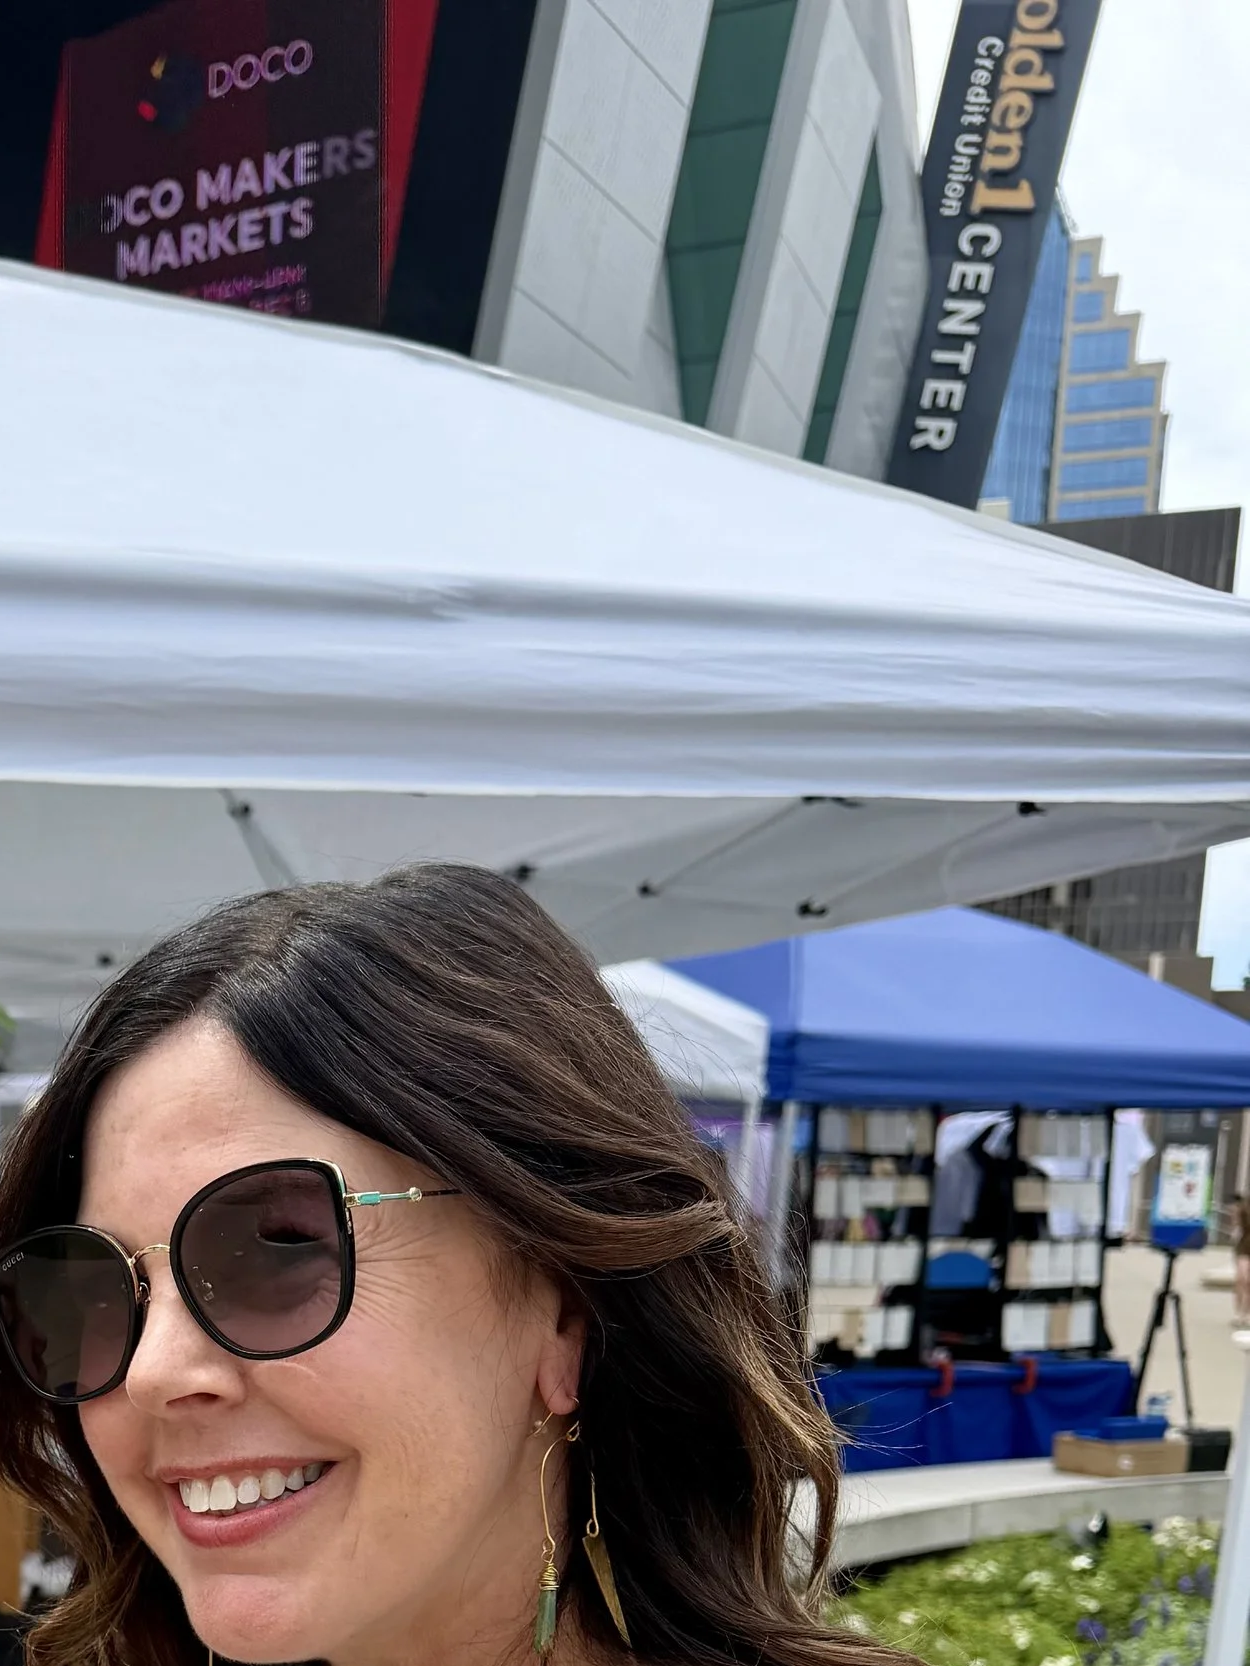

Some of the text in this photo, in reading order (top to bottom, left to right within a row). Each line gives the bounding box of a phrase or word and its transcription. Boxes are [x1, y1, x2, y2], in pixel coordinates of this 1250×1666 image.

[209, 40, 313, 98] DOCO
[939, 36, 1004, 216] Credit Union
[196, 129, 377, 211] MAKERS
[116, 197, 313, 281] MARKETS
[909, 223, 1002, 451] CENTER
